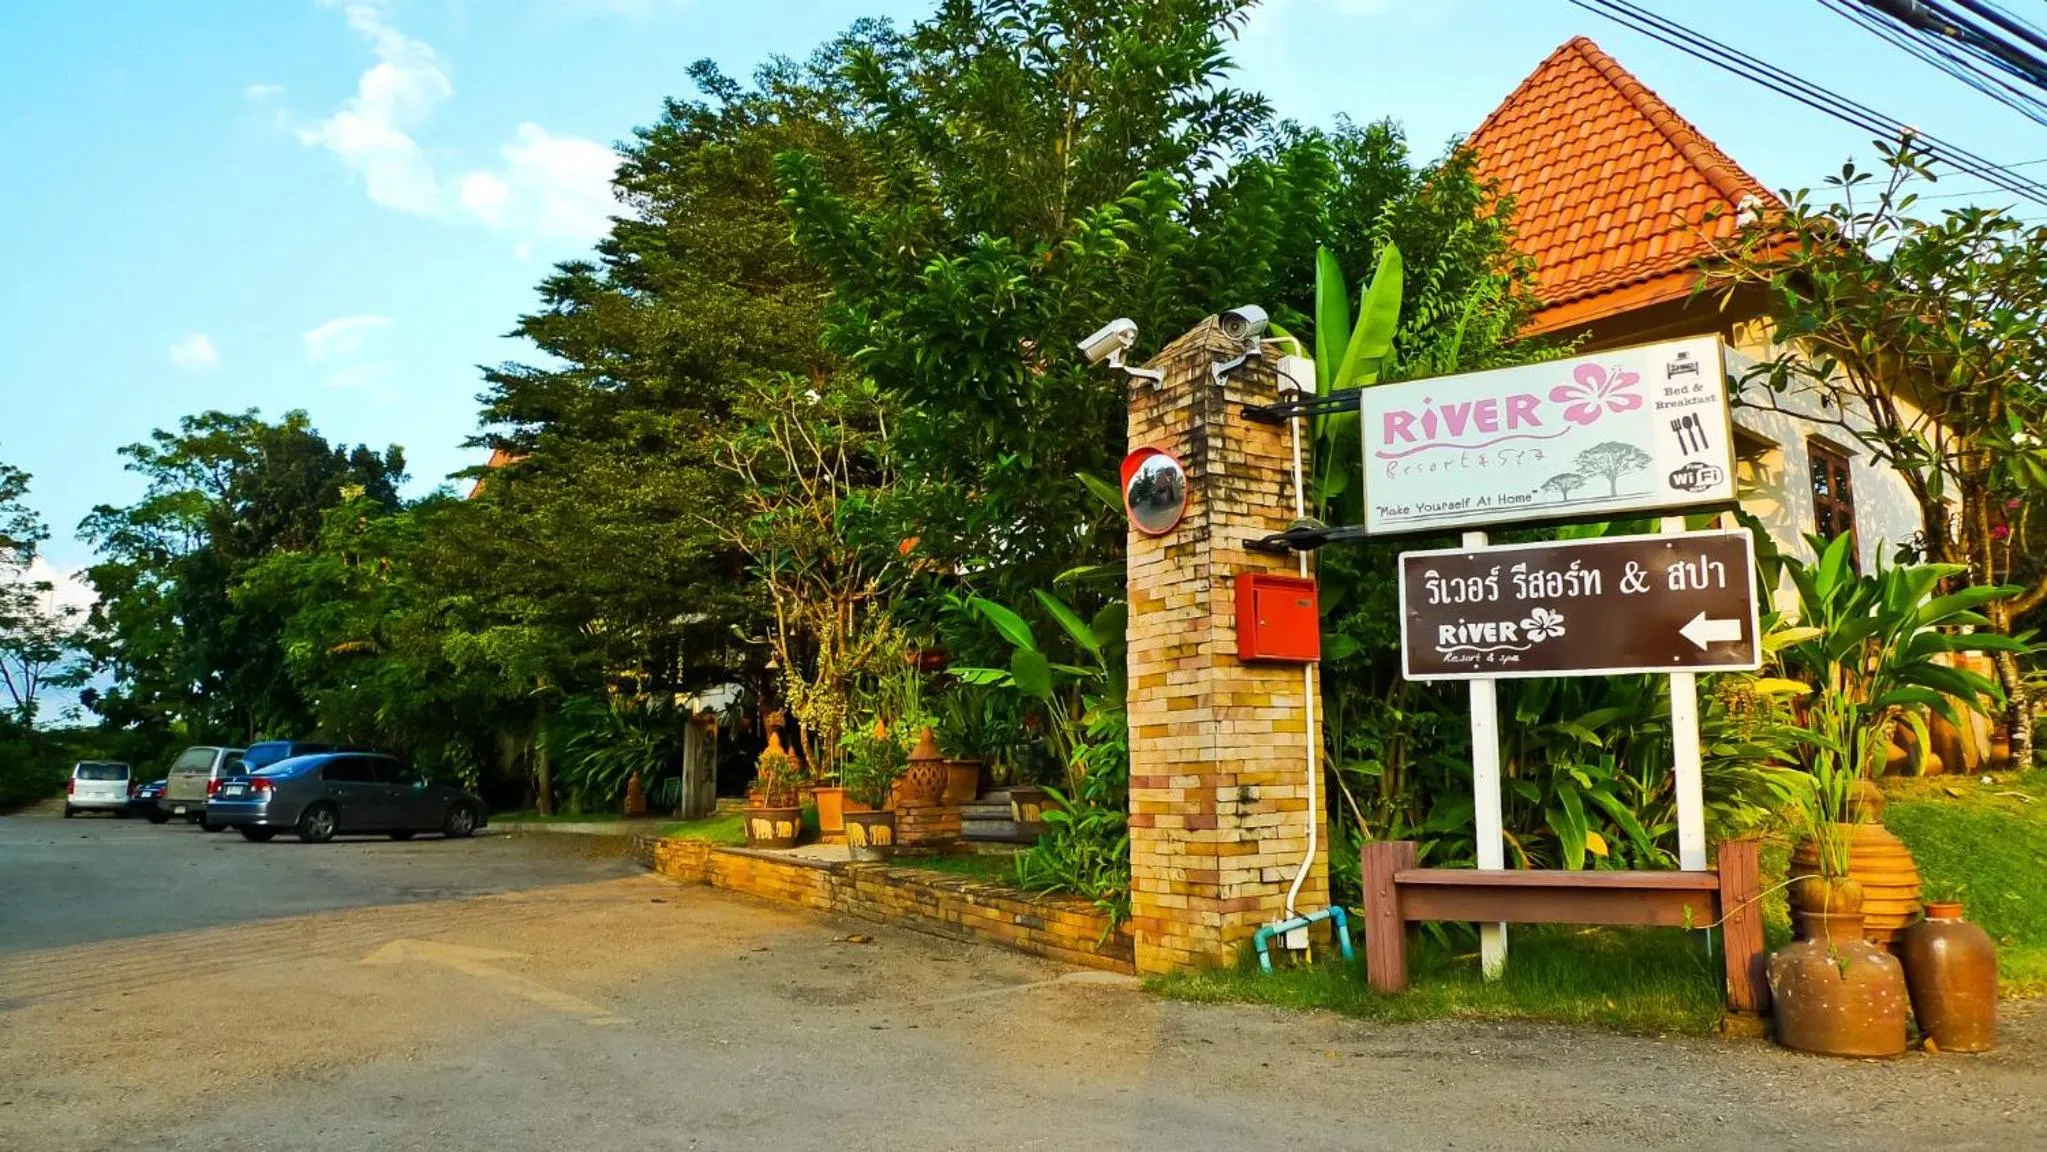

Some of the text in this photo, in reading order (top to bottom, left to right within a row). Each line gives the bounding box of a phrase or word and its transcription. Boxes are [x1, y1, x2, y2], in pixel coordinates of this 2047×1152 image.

[1664, 383, 1703, 396] Bed &
[1655, 395, 1717, 409] Breakfast
[1416, 497, 1471, 513] Yourself
[1477, 496, 1492, 506] At
[1424, 554, 1726, 605] ริเวอร์ รีสอร์ท & สปา
